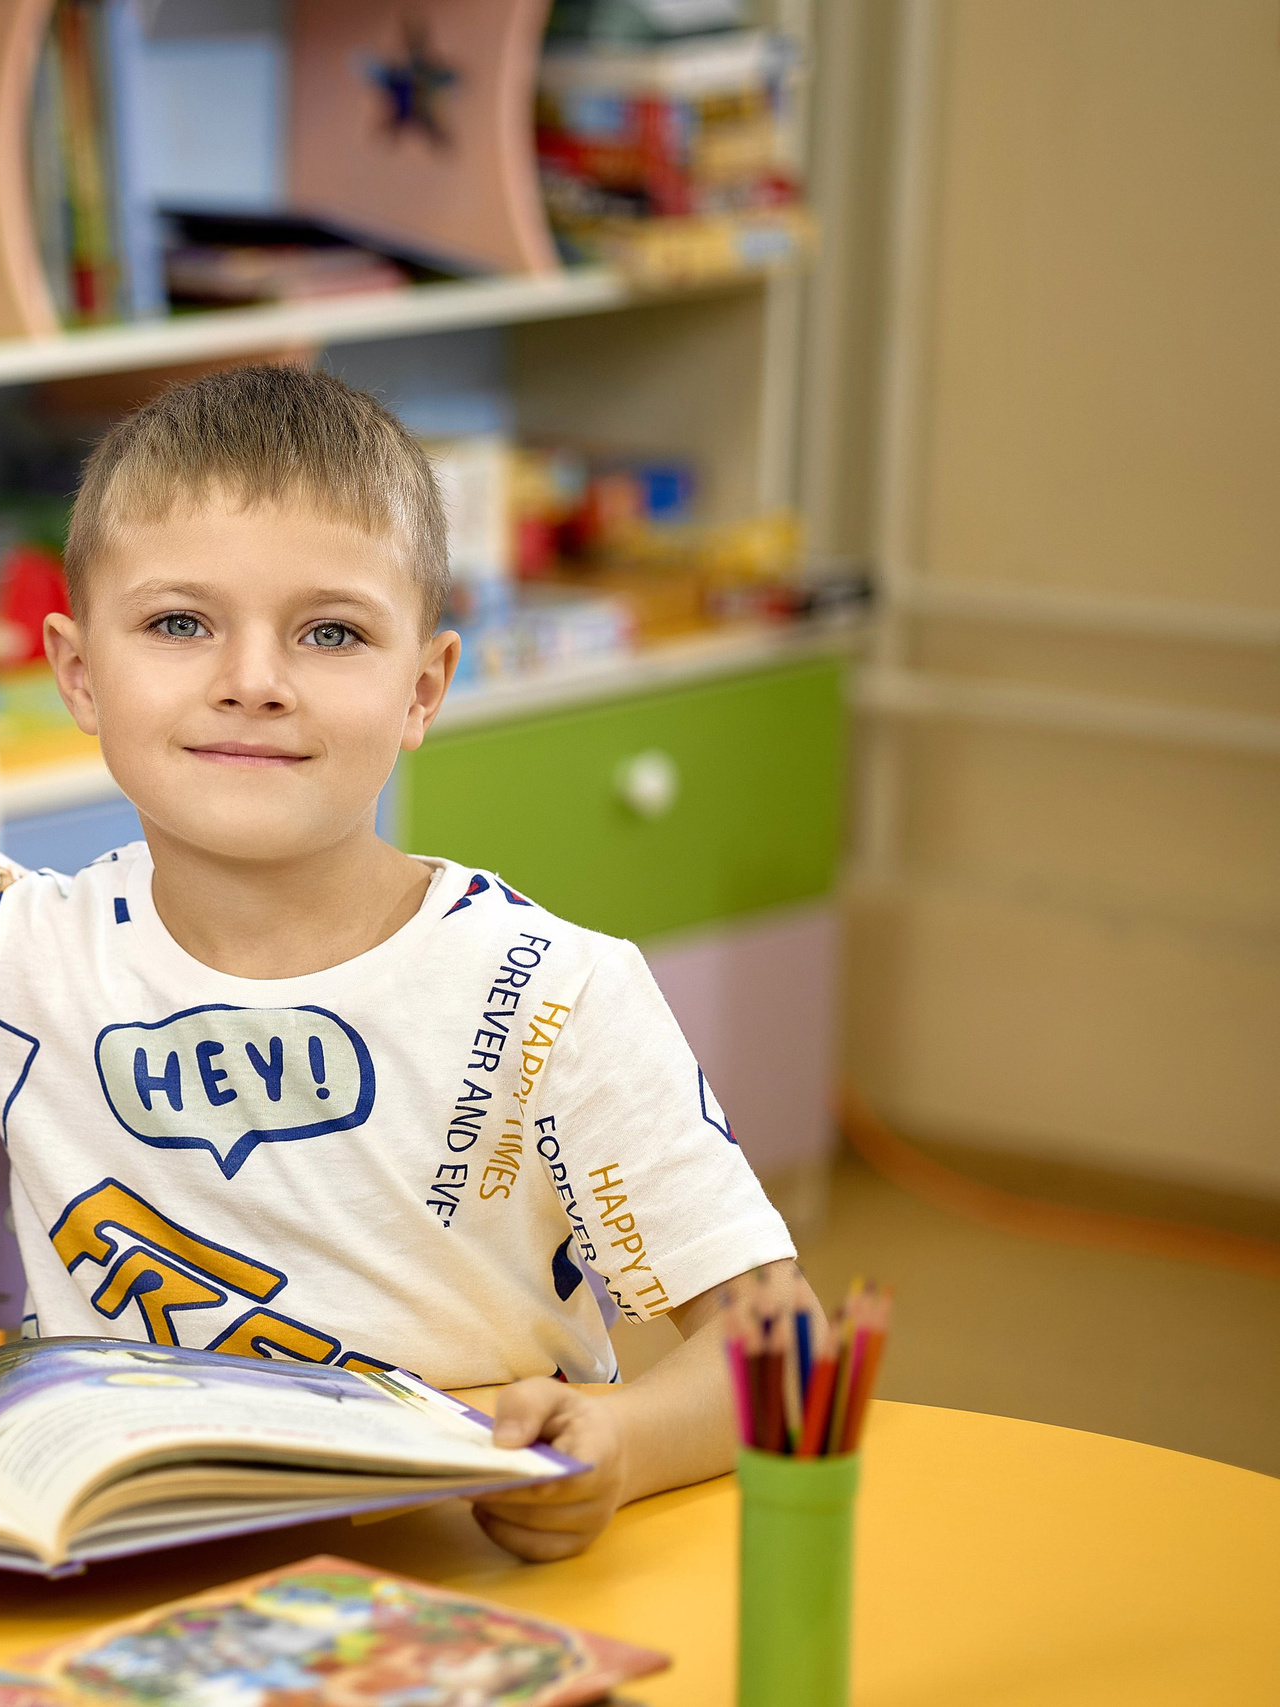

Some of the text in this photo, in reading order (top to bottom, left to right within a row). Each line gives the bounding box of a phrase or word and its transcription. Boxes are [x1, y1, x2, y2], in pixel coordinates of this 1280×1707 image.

[134, 1036, 330, 1111] HEY!
[425, 934, 551, 1229] FOREVER AND EVE
[536, 1116, 596, 1264] FOREVER
[589, 1163, 651, 1272] HAPPY
